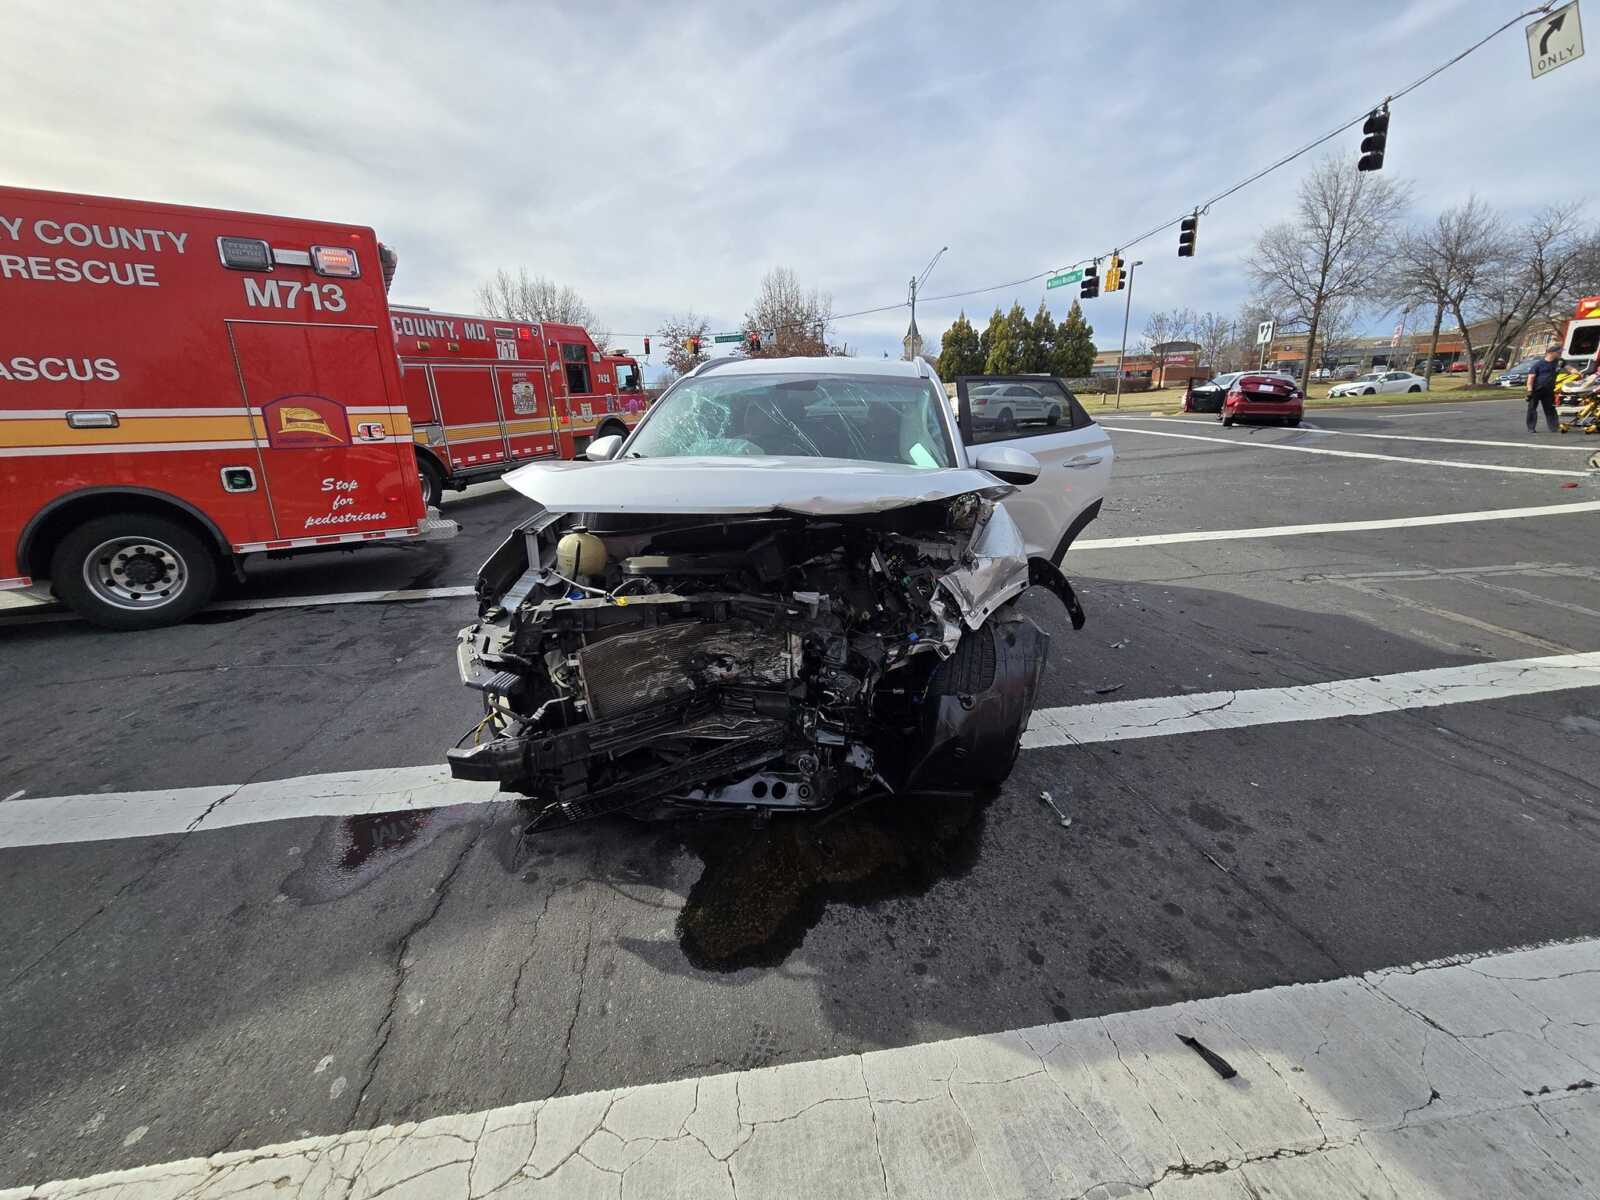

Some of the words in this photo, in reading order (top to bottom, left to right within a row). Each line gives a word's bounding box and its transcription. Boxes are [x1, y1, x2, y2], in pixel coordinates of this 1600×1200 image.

[1537, 44, 1576, 71] ONLY
[34, 219, 189, 254] COUNTY
[0, 254, 160, 287] RESCUE
[243, 277, 347, 312] M713
[390, 316, 459, 340] COUNTY,
[464, 322, 490, 342] MD.
[321, 477, 359, 492] Stop
[332, 495, 354, 510] for
[304, 511, 387, 529] pedestrians
